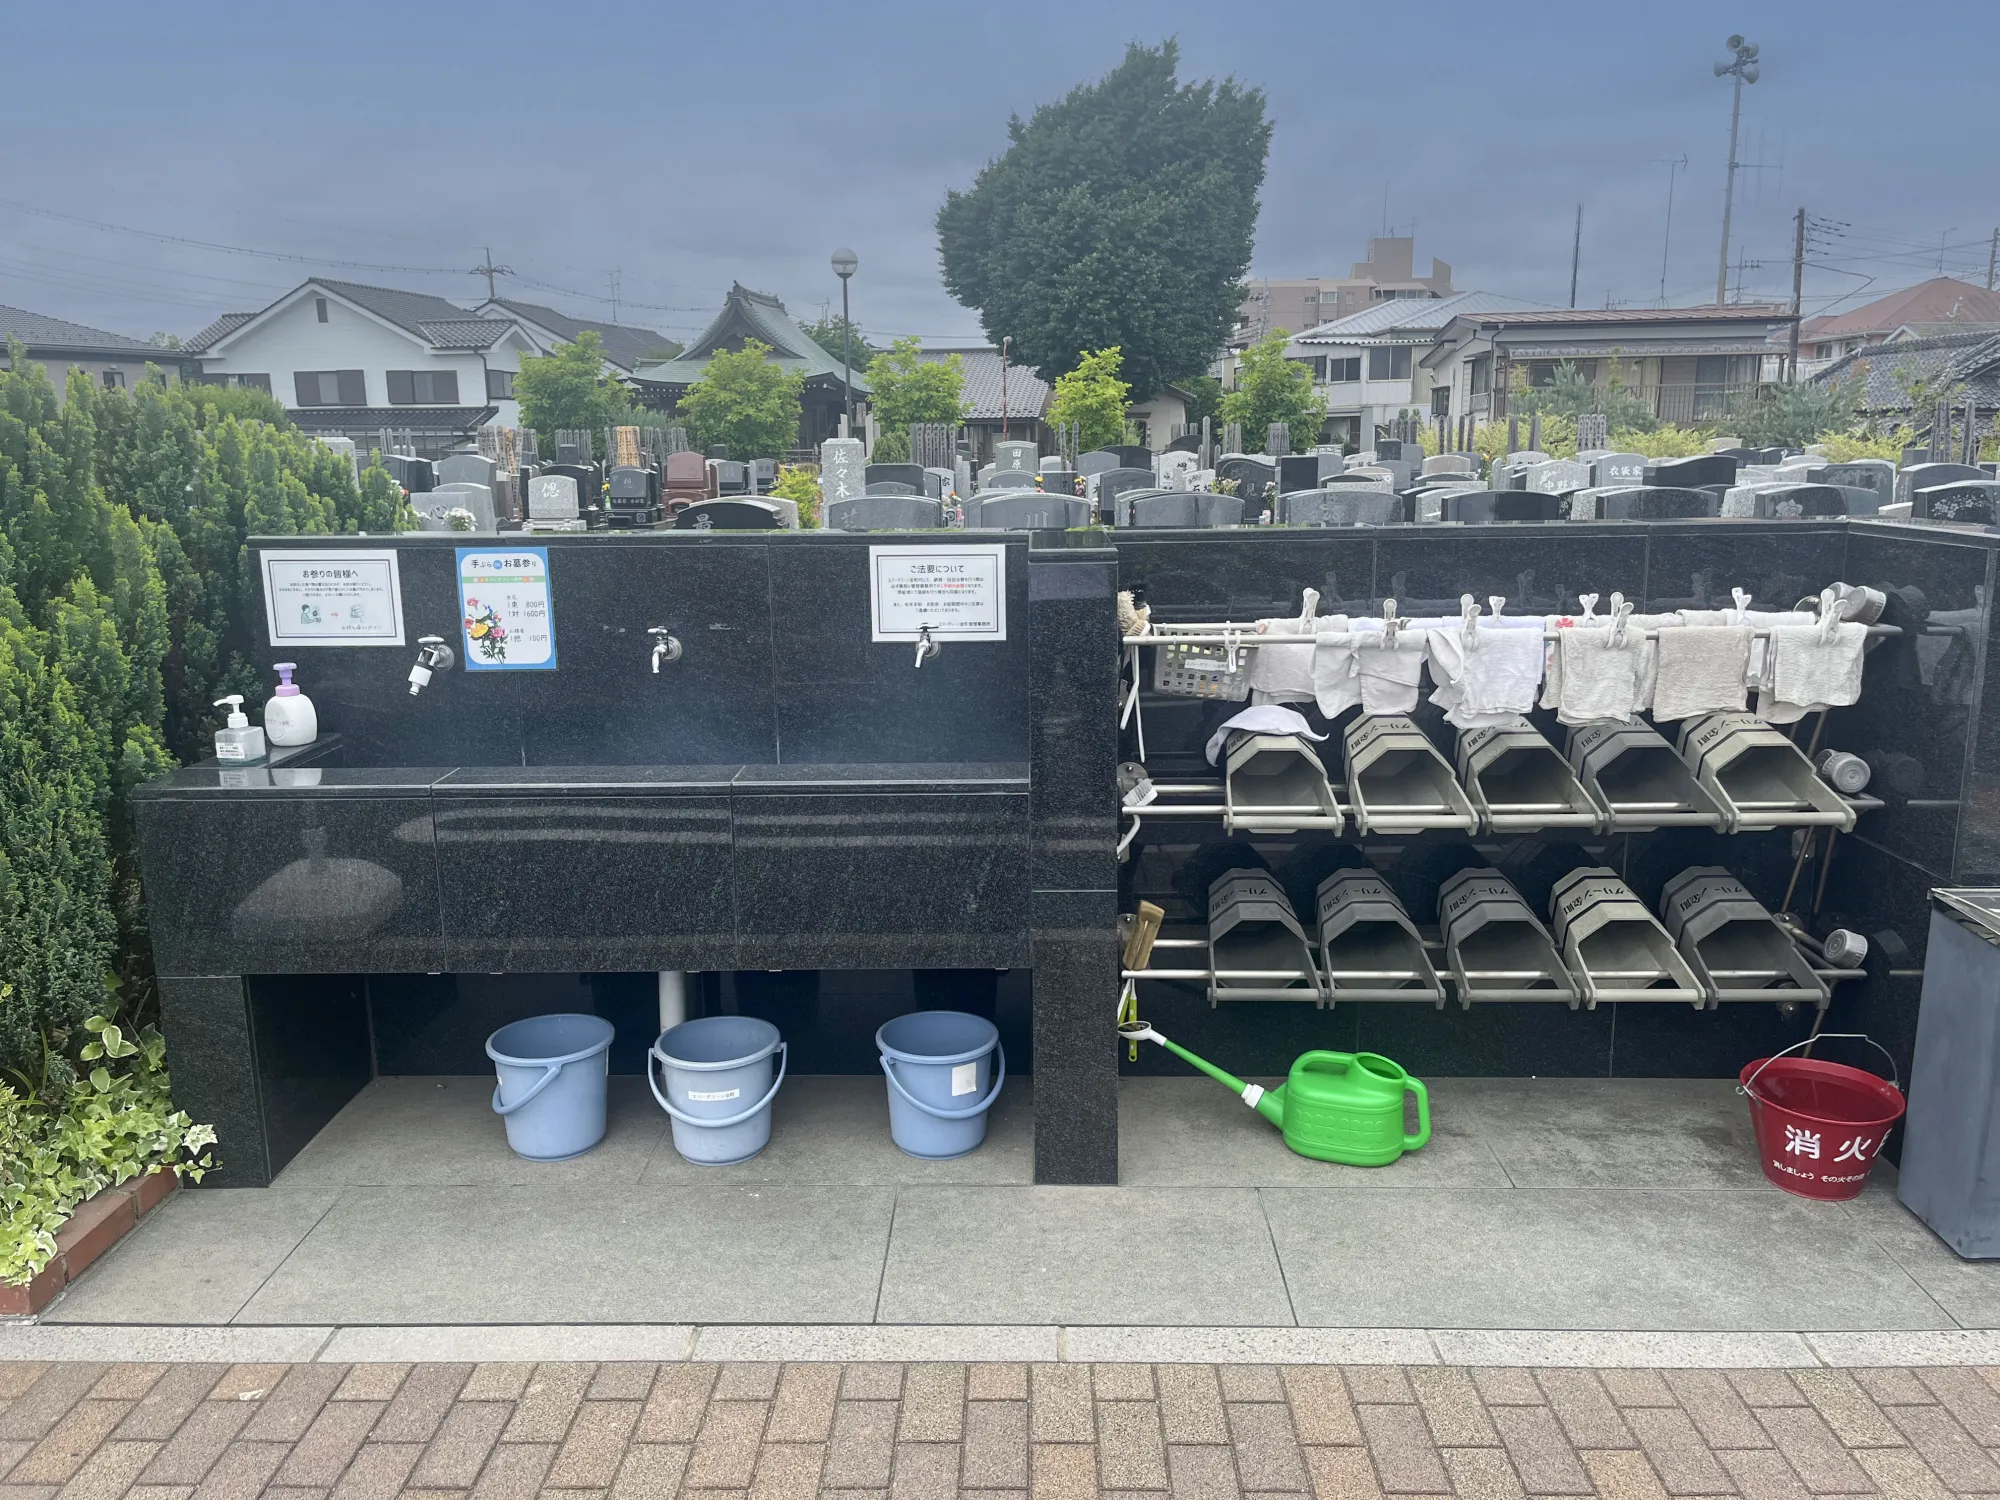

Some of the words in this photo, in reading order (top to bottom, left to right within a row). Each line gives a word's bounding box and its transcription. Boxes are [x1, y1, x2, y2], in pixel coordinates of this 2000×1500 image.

[1012, 449, 1022, 469] 田原
[833, 449, 850, 498] 佐々木
[1608, 465, 1642, 477] 衣袋家
[302, 569, 359, 579] お参りの皆様へ
[910, 565, 965, 574] ご法要について
[523, 610, 546, 618] 1600円
[529, 634, 548, 642] 100円
[1784, 1124, 1893, 1163] 消火
